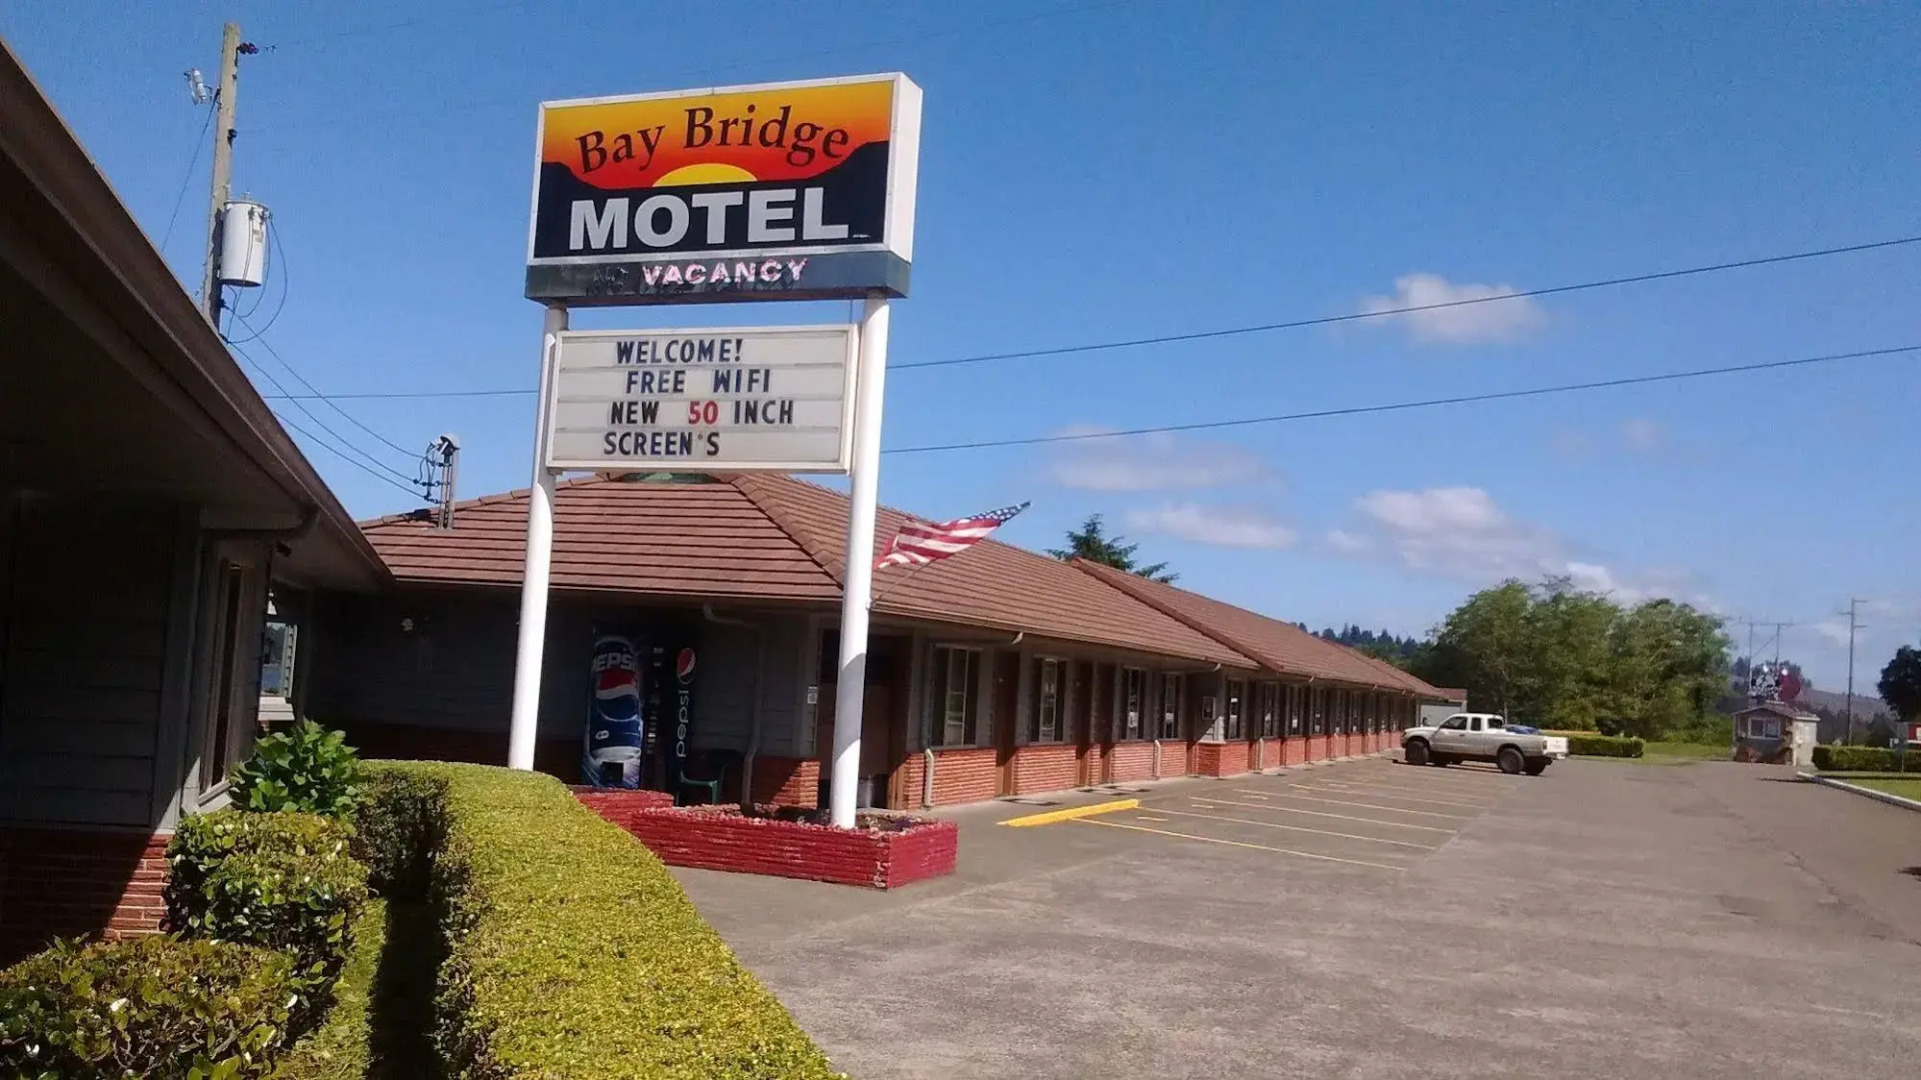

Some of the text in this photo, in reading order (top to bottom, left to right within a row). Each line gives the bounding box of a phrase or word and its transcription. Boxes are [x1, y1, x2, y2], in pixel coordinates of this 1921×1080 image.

[575, 104, 849, 174] Bay Bridge
[569, 187, 849, 251] MOTEL
[641, 257, 809, 286] VACANCY
[616, 338, 743, 364] WELCOME!
[626, 369, 771, 394] FREE WIFI
[610, 400, 794, 425] NEW 50 INCH
[604, 432, 720, 456] SCREEN'S
[676, 690, 690, 758] pepsi
